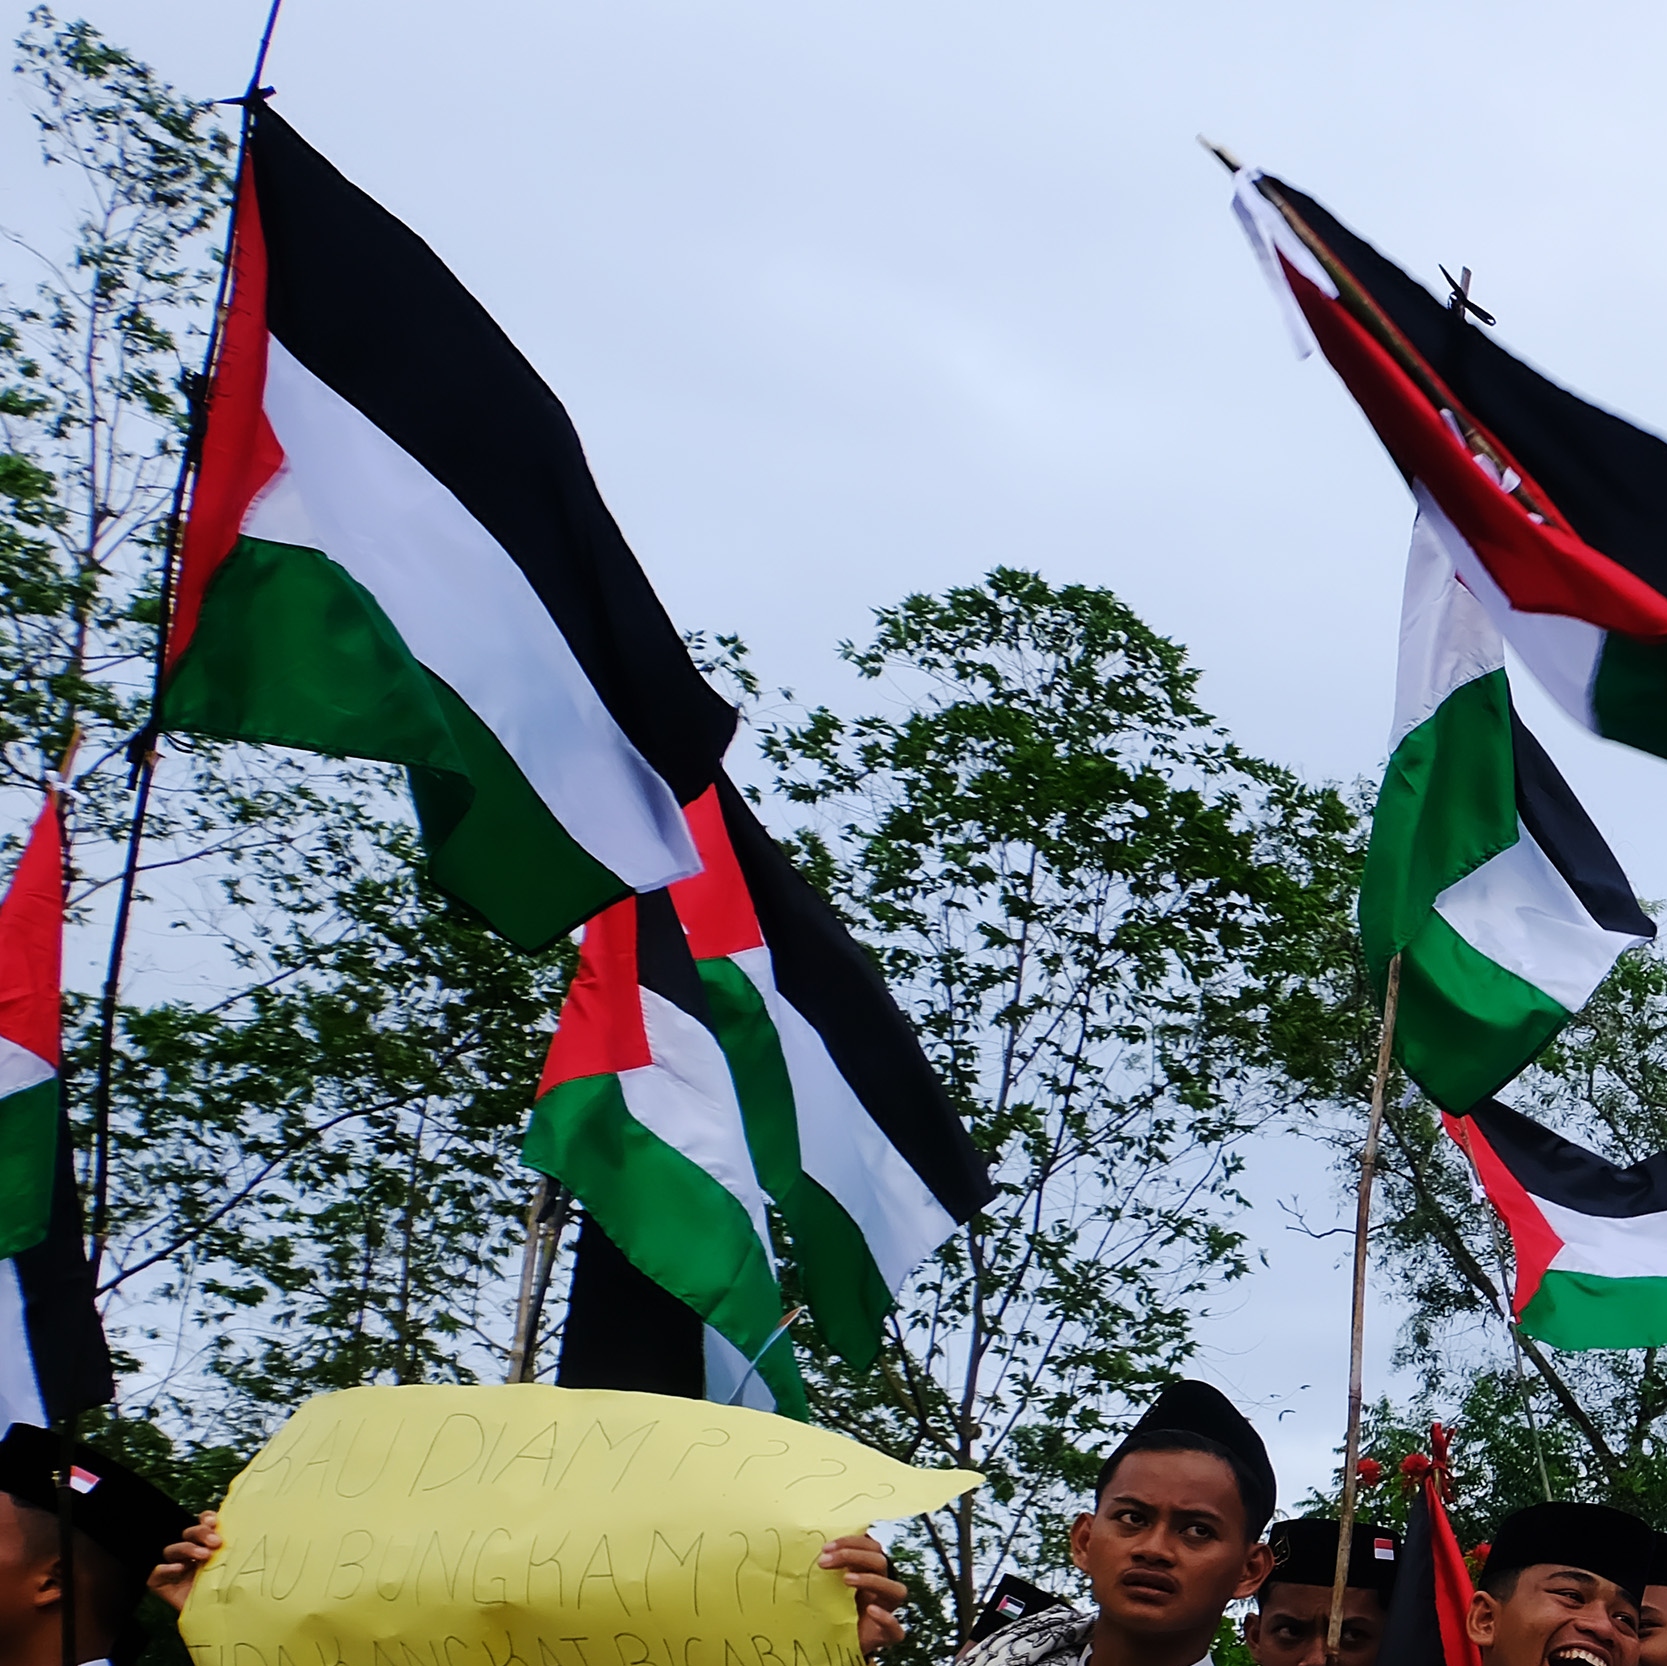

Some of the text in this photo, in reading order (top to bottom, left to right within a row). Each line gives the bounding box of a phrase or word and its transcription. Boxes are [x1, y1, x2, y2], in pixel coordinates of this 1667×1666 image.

[231, 1418, 405, 1504] KAU
[408, 1413, 660, 1497] DIAM
[324, 1527, 704, 1617] BUNGKAM
